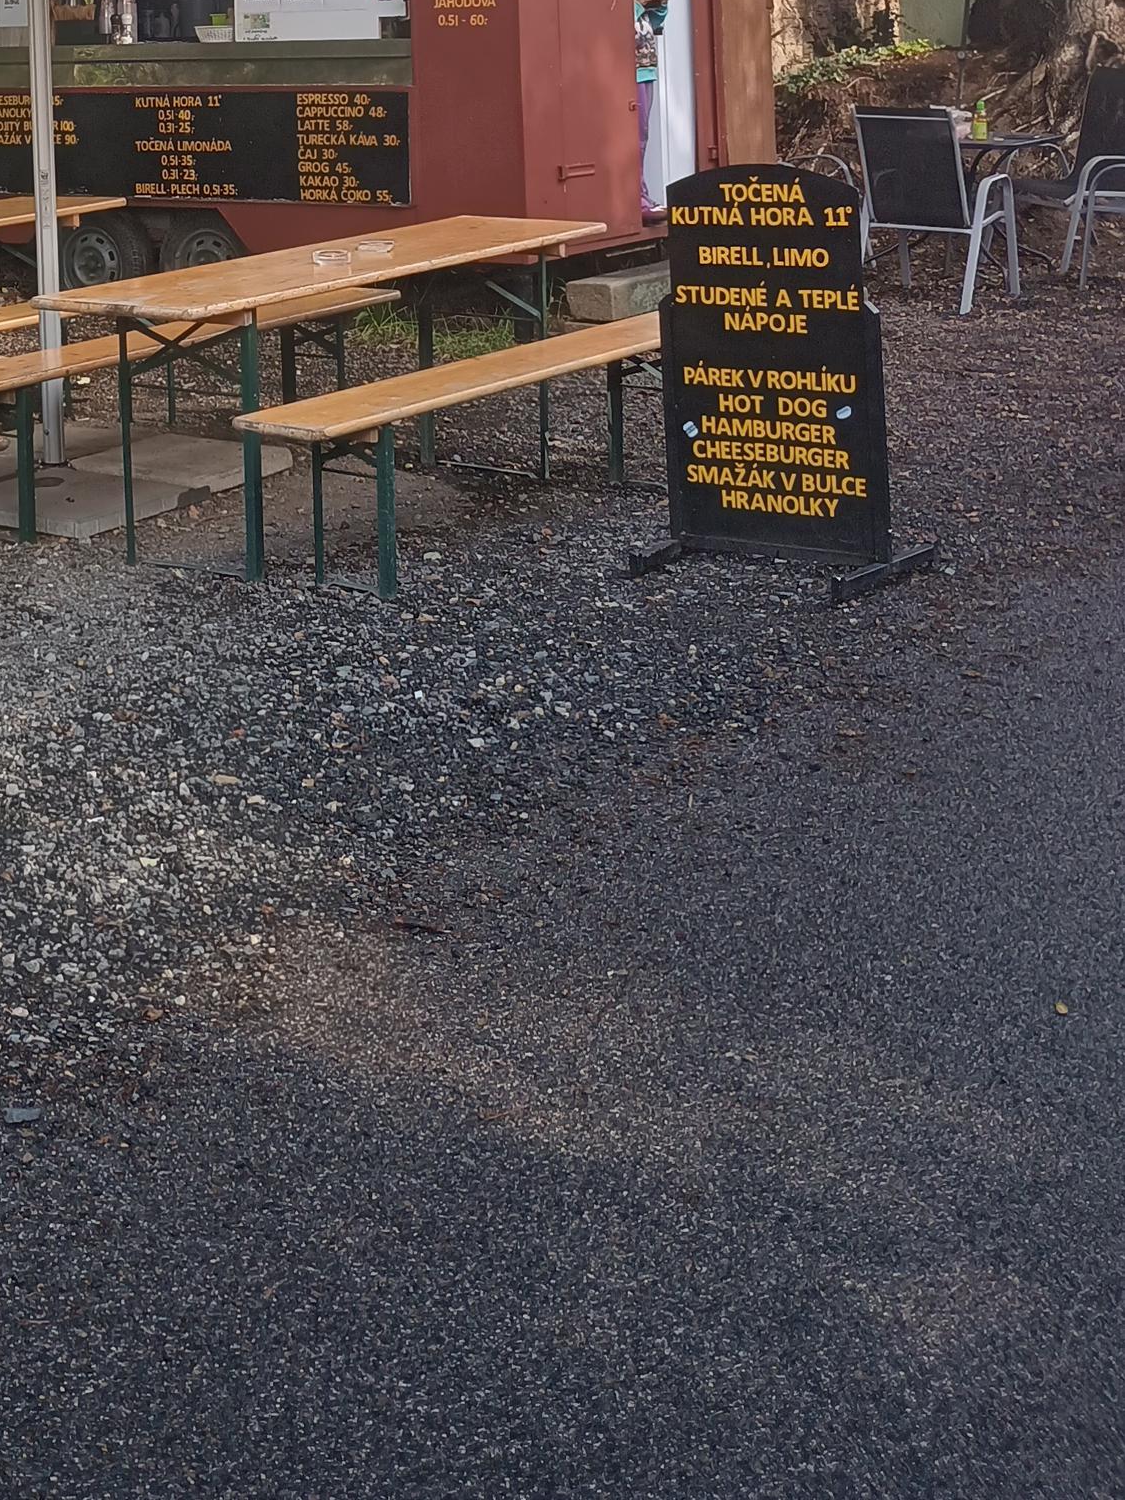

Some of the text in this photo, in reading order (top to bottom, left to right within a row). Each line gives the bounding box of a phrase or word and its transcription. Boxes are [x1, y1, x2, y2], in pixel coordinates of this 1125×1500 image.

[135, 94, 170, 108] KUTNÁ
[173, 96, 202, 107] HORA
[296, 93, 348, 105] ESPRESSO
[296, 106, 364, 117] CAPPUCCINO
[297, 120, 330, 131] LATTE
[24, 134, 31, 144] V
[135, 136, 232, 152] TOČENÁ LIMONÁDA
[296, 131, 346, 145] TURECKÁ
[350, 131, 378, 146] KÁVA
[297, 146, 317, 159] ČAJ
[298, 161, 329, 173] GROG
[299, 175, 339, 187] KAKAO
[719, 176, 805, 203] TOČENÁ
[300, 187, 338, 201] HORKÁ
[341, 187, 371, 201] ČOKO
[671, 202, 852, 227] KUTNÁ HORA 11°
[773, 247, 830, 268] LIMO
[675, 280, 860, 311] STUDENÉ A TEPLÉ
[724, 306, 808, 334] NÁPOJE
[683, 360, 856, 393] PÁREK V ROHLÍKU
[718, 393, 827, 418] HOT DOG
[701, 415, 836, 445] HAMBURGER
[692, 440, 850, 470] CHEESEBURGER
[687, 462, 867, 497] SMAŽÁK V BULCE
[721, 490, 839, 517] HRANOLKY
